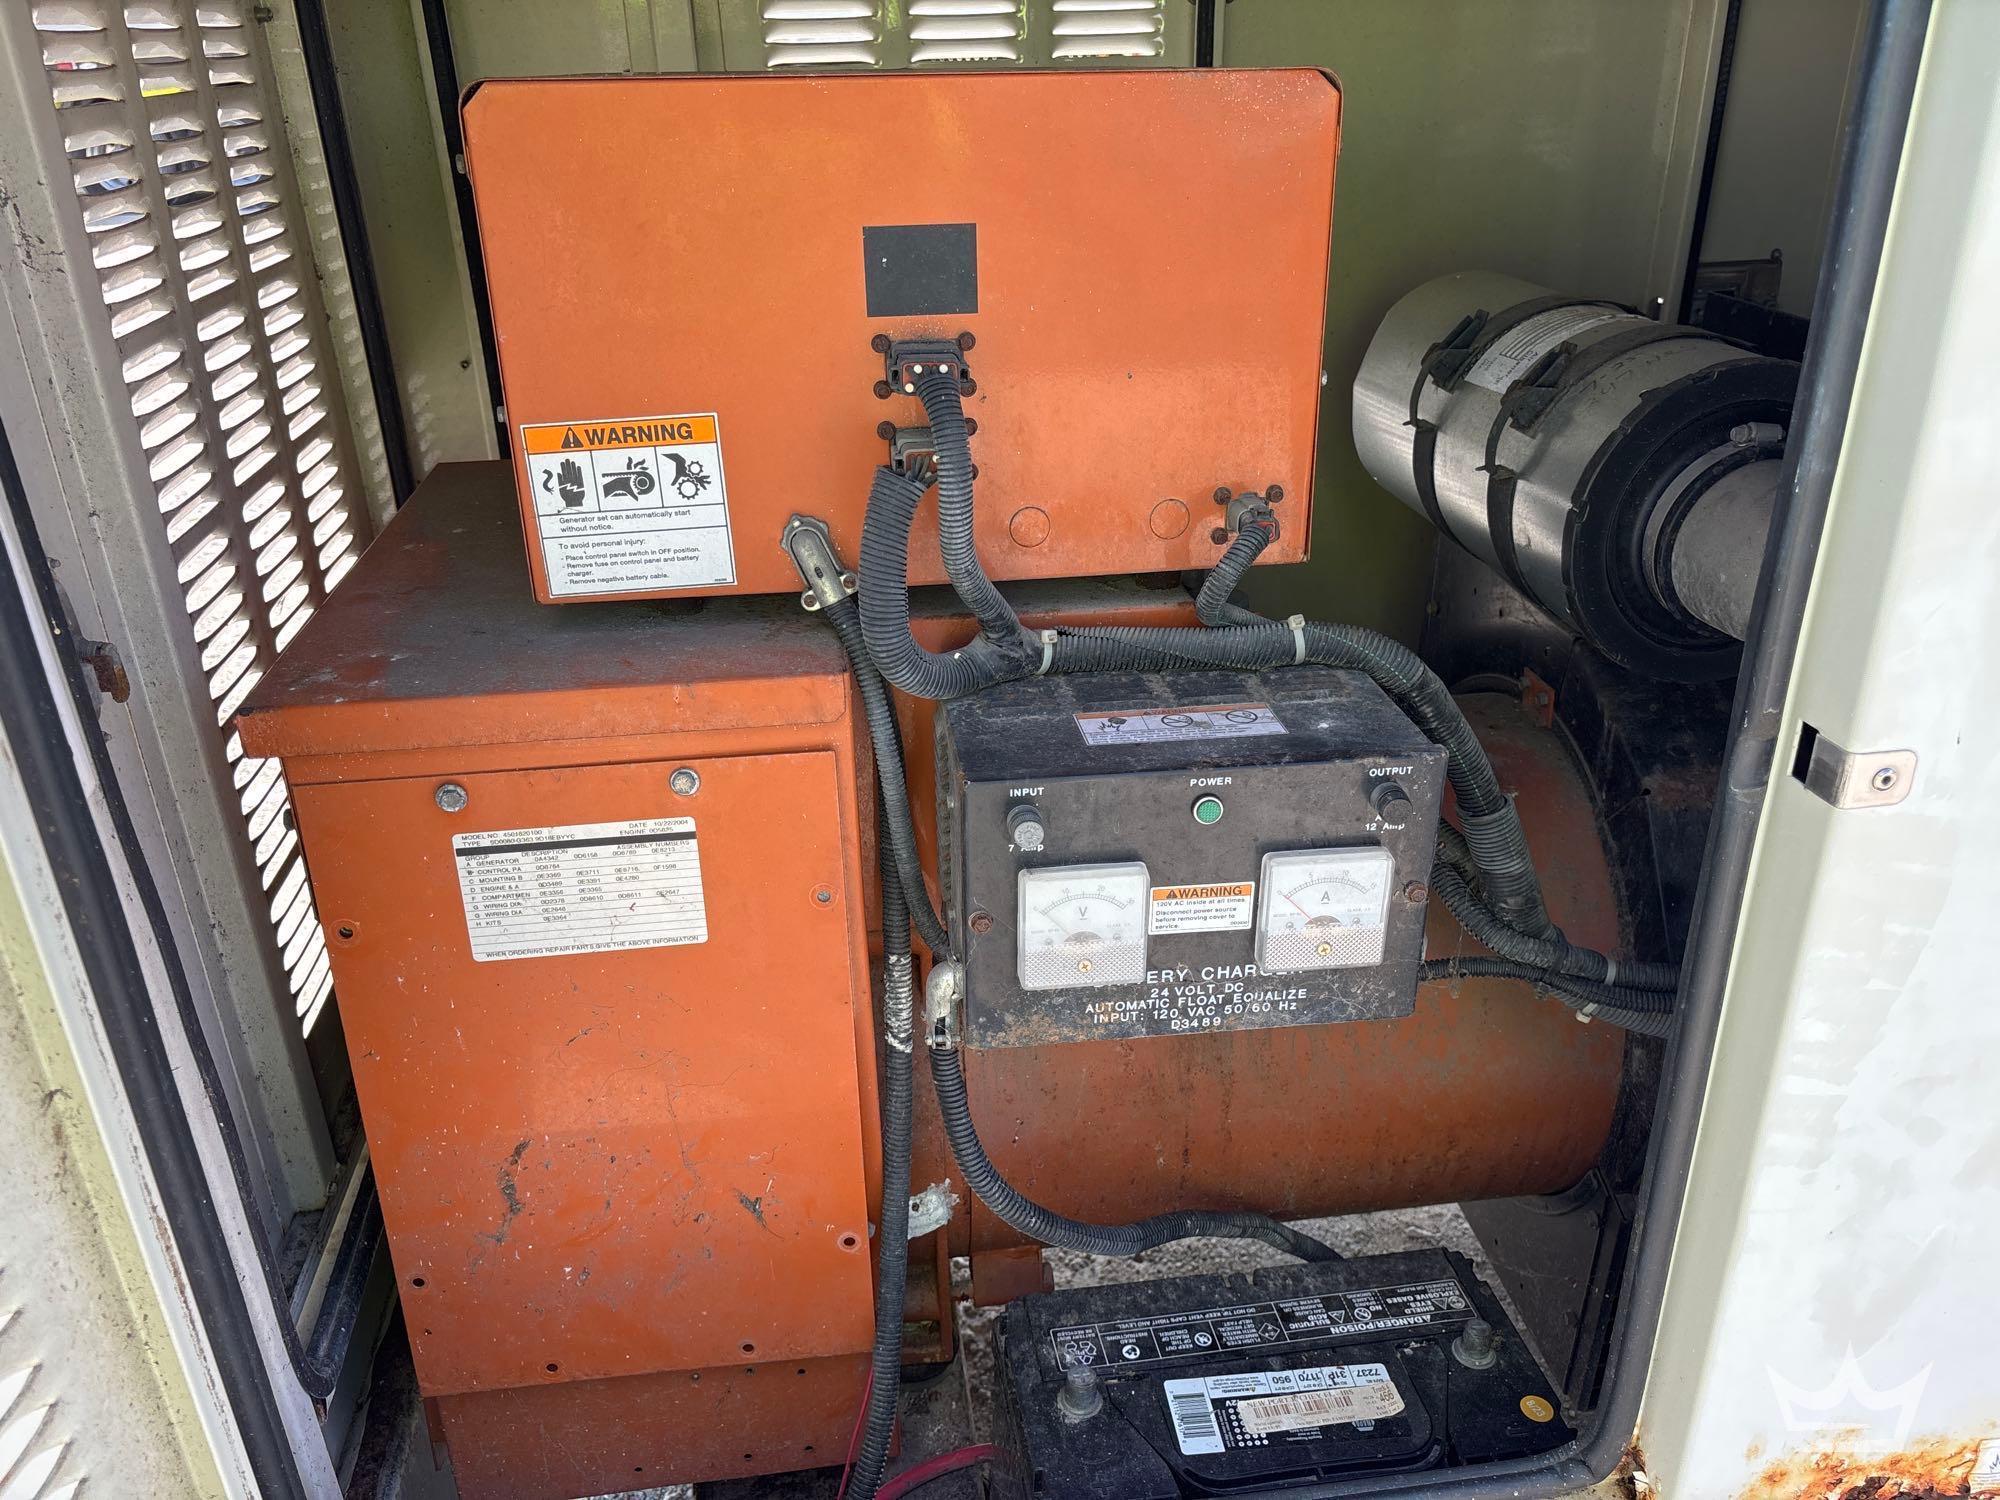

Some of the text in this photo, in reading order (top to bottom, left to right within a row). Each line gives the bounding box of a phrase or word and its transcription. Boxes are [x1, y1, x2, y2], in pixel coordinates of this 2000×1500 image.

[584, 422, 693, 445] WARNING
[559, 515, 594, 524] Generator
[597, 514, 608, 522] set
[609, 513, 623, 521] can
[624, 510, 671, 520] automatically
[560, 523, 613, 532] without notice.
[570, 541, 589, 549] avoid
[590, 539, 622, 548] personal
[623, 537, 645, 546] injury:
[609, 551, 627, 559] panel
[673, 546, 700, 555] position.
[566, 561, 593, 569] Remove
[643, 557, 661, 565] panel
[676, 554, 699, 562] battery
[567, 570, 594, 578] charger.
[596, 575, 624, 584] negative
[625, 574, 648, 582] battery
[1369, 766, 1413, 777] OUTPUT
[1190, 776, 1232, 787] POWER
[1009, 787, 1045, 797] INPUT
[1365, 822, 1377, 831] 12
[655, 839, 689, 847] NUMBERS
[1008, 844, 1014, 852] 7
[521, 848, 568, 857] DESCRIPTION
[475, 858, 519, 866] GENERATOR
[481, 892, 530, 900] COMPARTMEN
[1179, 886, 1241, 898] WARNING
[1320, 890, 1330, 902] A
[1078, 906, 1088, 918] V
[1193, 907, 1212, 915] power
[1177, 914, 1207, 922] removing
[507, 948, 543, 956] ORDERING
[652, 935, 698, 944] INFORMATION
[1201, 964, 1304, 981] CHAR
[1150, 983, 1244, 998] 24 VOLT DC
[1085, 988, 1308, 1014] AUTOMATIC FLOAT EQUALIZE
[1093, 1012, 1144, 1024] INPUT:
[1187, 1006, 1216, 1017] VAC
[1223, 1002, 1271, 1014] 50/60
[1278, 1000, 1298, 1011] Hz
[1170, 1016, 1222, 1030] D3489
[1414, 1289, 1460, 1299] EXPLOSIVE
[1403, 1305, 1435, 1313] SHIELD
[1288, 1318, 1330, 1328] SULFURIC
[1329, 1315, 1423, 1333] DANGER/POISON
[1352, 1367, 1380, 1378] 7237
[1271, 1375, 1292, 1385] 950
[1247, 1400, 1265, 1408] NEW
